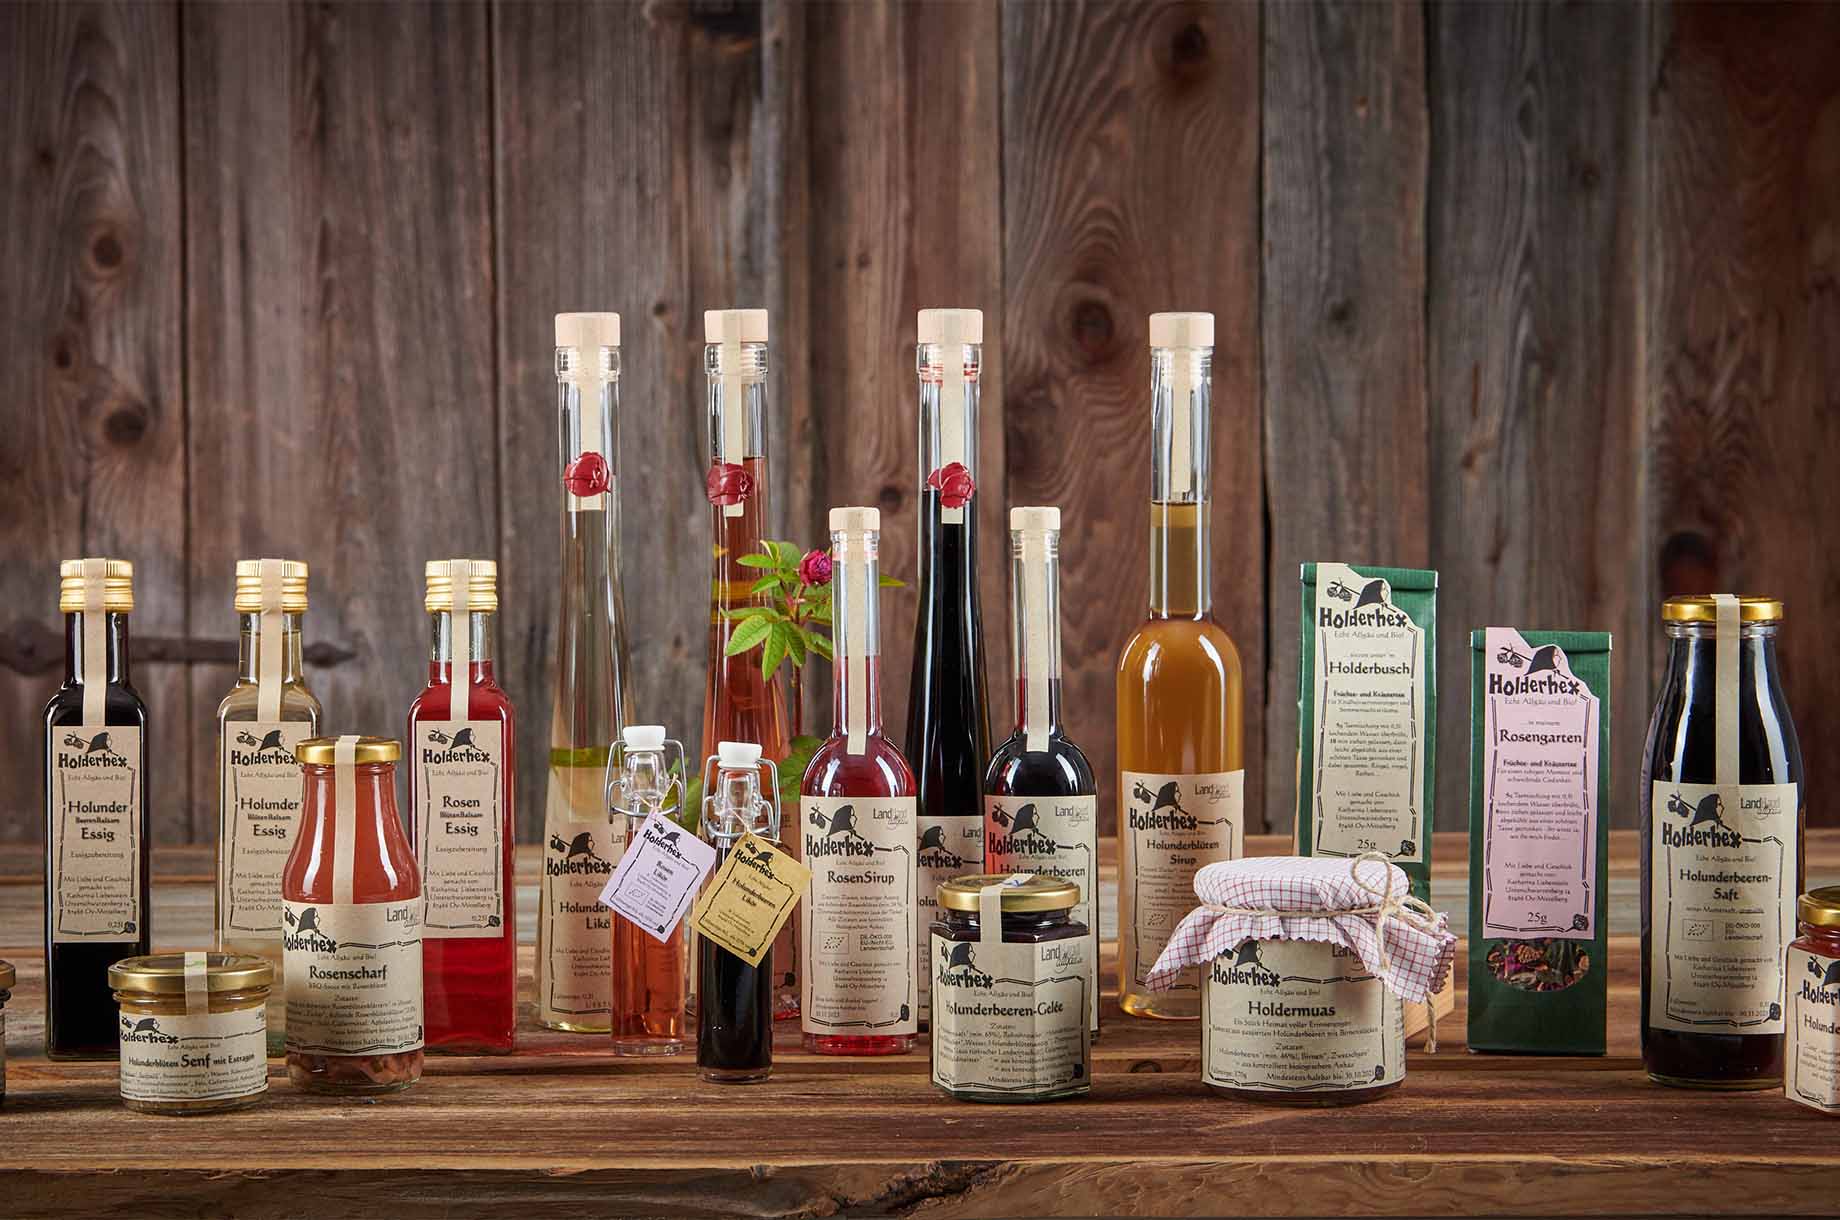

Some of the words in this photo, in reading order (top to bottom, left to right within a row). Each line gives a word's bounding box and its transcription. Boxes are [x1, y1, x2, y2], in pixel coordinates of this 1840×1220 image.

[1320, 607, 1408, 629] Holderhex
[1330, 662, 1410, 675] Holderbusch
[1489, 673, 1580, 696] Holderhex
[1500, 729, 1582, 745] Rosengarten
[58, 753, 127, 769] Holderhex
[231, 750, 298, 766] Holderhex
[423, 749, 490, 764] Holderhex
[1195, 784, 1214, 795] Land
[68, 801, 128, 813] Holunder
[240, 798, 299, 811] Holunder
[443, 796, 480, 808] Rosen
[1741, 798, 1761, 809] Land
[873, 808, 892, 820] Land
[1055, 806, 1074, 816] Land
[1130, 808, 1198, 830] Holderhex
[81, 827, 115, 842] Essig
[253, 824, 286, 839] Essig
[446, 822, 478, 836] Essig
[1663, 821, 1742, 848] Holderhex
[611, 832, 625, 844] Lan
[643, 829, 682, 859] Holderhex
[806, 834, 874, 857] Holderhex
[989, 832, 1057, 855] Holderhex
[1147, 840, 1220, 851] Holunderblüten
[1358, 839, 1377, 850] 25g
[547, 857, 612, 875] Holderhex
[734, 849, 775, 880] Holderhex
[1170, 855, 1197, 866] Sirup
[827, 871, 895, 886] RosenSirup
[1680, 869, 1772, 884] Holunderbeeren-
[1713, 888, 1739, 902] Saft
[387, 906, 408, 922] Land
[560, 902, 609, 913] Holunder
[586, 917, 610, 929] Likö
[1528, 912, 1547, 924] 25g
[1041, 946, 1061, 961] Land
[1332, 945, 1355, 958] Lan
[310, 965, 387, 980] Rosenscharf
[1213, 963, 1281, 988] Holderhex
[1802, 980, 1840, 1005] Holder
[1248, 1001, 1336, 1017] Holdermuas
[1804, 1014, 1840, 1034] Holunde
[181, 1053, 211, 1068] Senf
